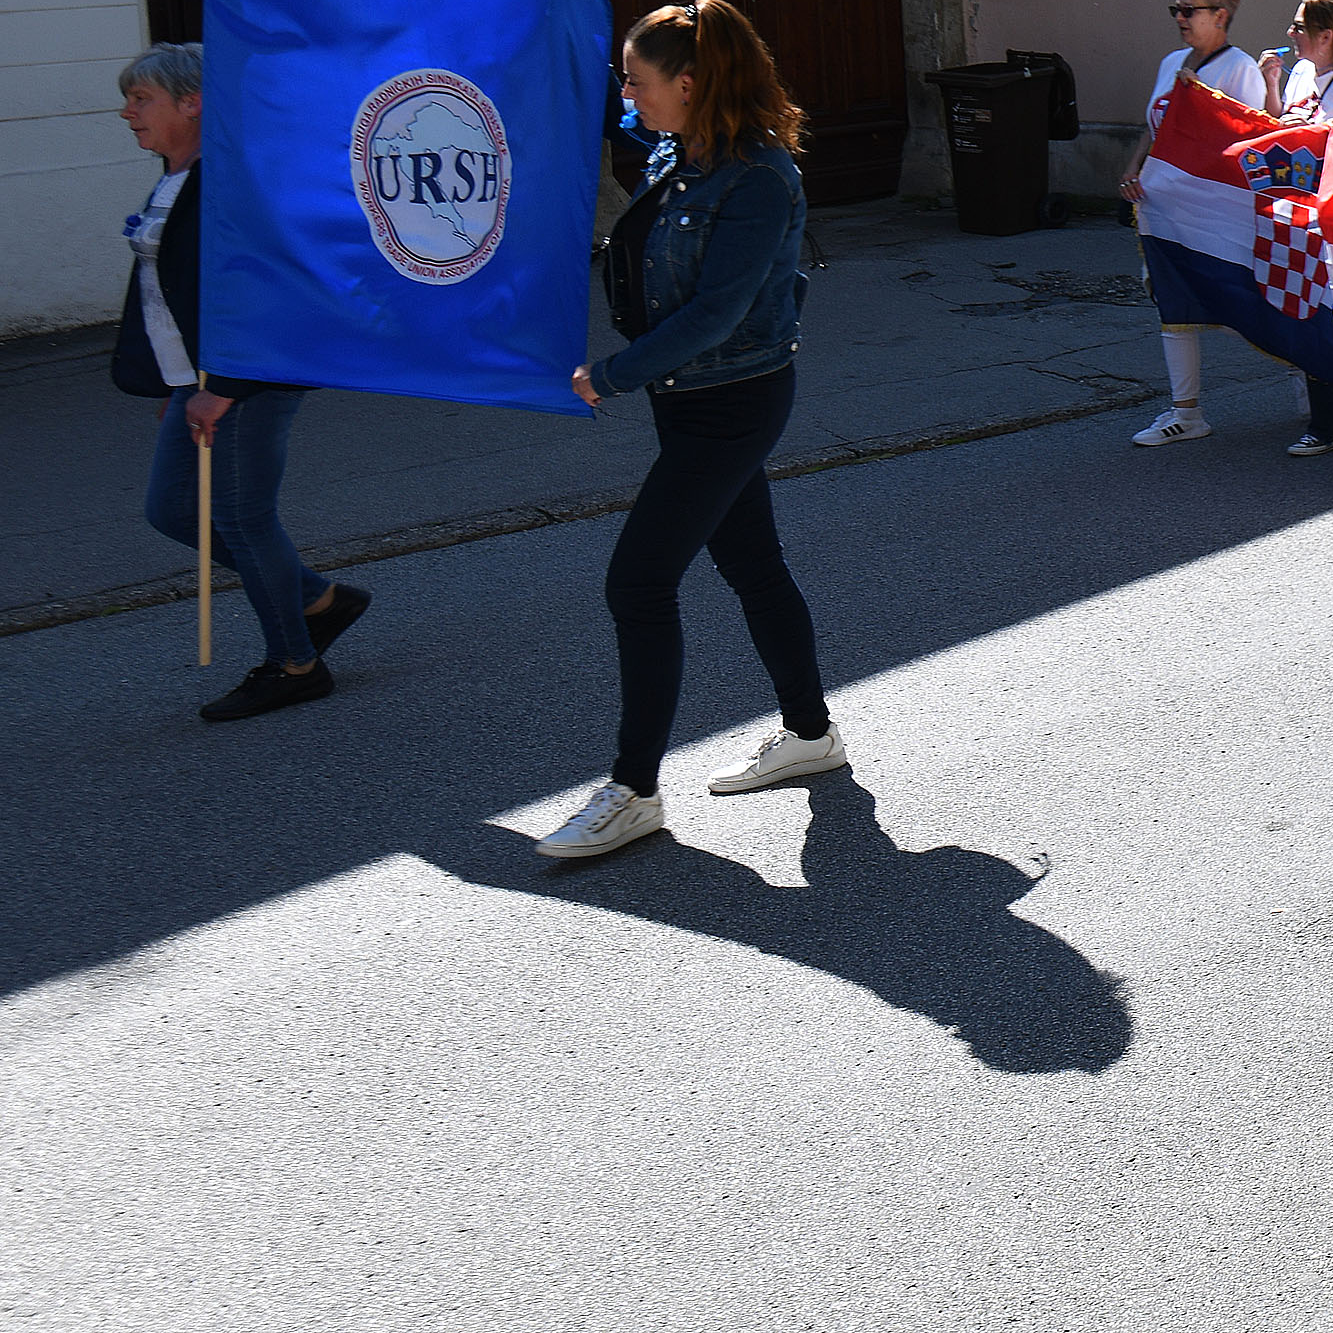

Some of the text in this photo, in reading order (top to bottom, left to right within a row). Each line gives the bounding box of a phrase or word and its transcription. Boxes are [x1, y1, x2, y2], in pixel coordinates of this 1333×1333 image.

[366, 75, 423, 115] RADNIČKIH
[426, 73, 479, 100] SINDIKATA
[373, 149, 499, 204] URSH
[381, 235, 407, 267] TRADE
[407, 260, 437, 278] UNION
